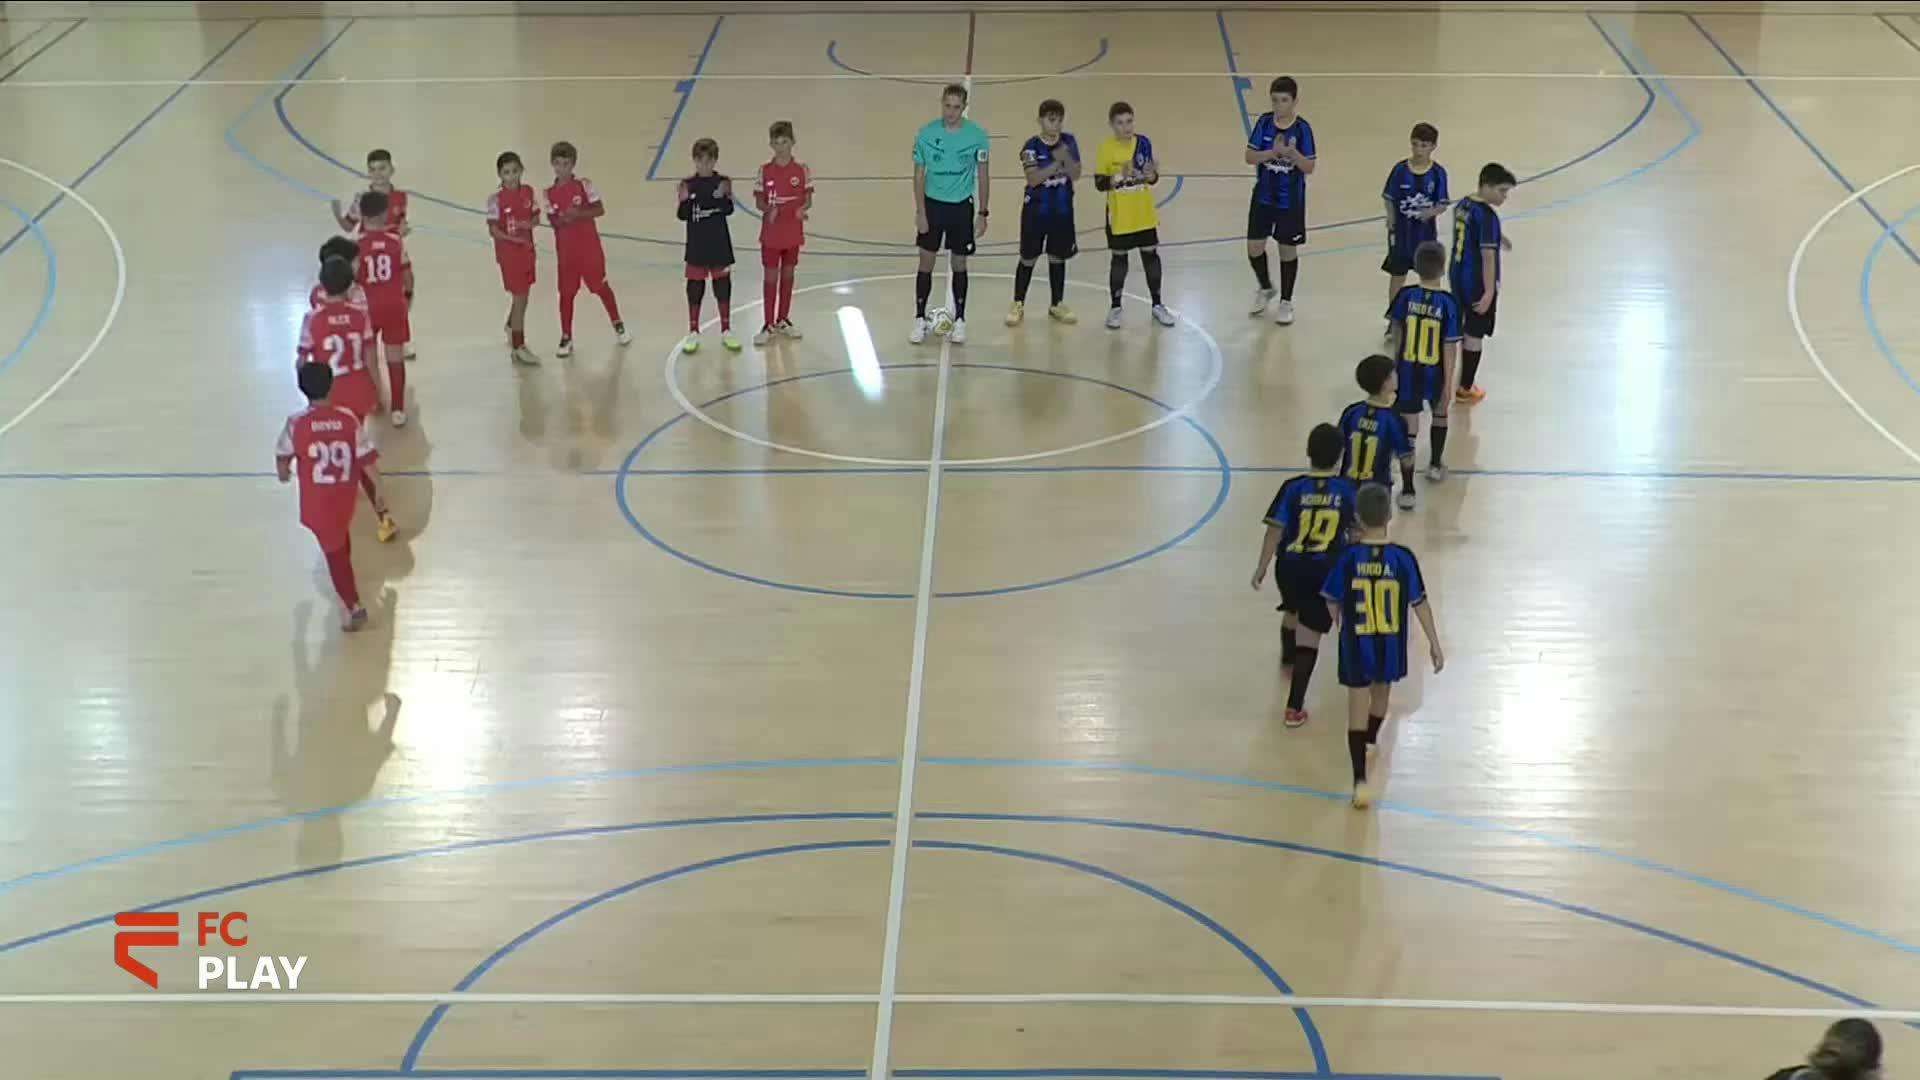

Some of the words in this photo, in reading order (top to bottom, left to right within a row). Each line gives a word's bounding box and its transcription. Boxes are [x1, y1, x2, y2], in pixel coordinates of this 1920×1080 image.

[364, 255, 392, 283] 18
[323, 333, 363, 376] 21
[1403, 314, 1441, 366] 10
[308, 440, 352, 484] 29
[1346, 431, 1379, 481] 11
[1290, 508, 1341, 553] 19
[1351, 578, 1400, 636] 30
